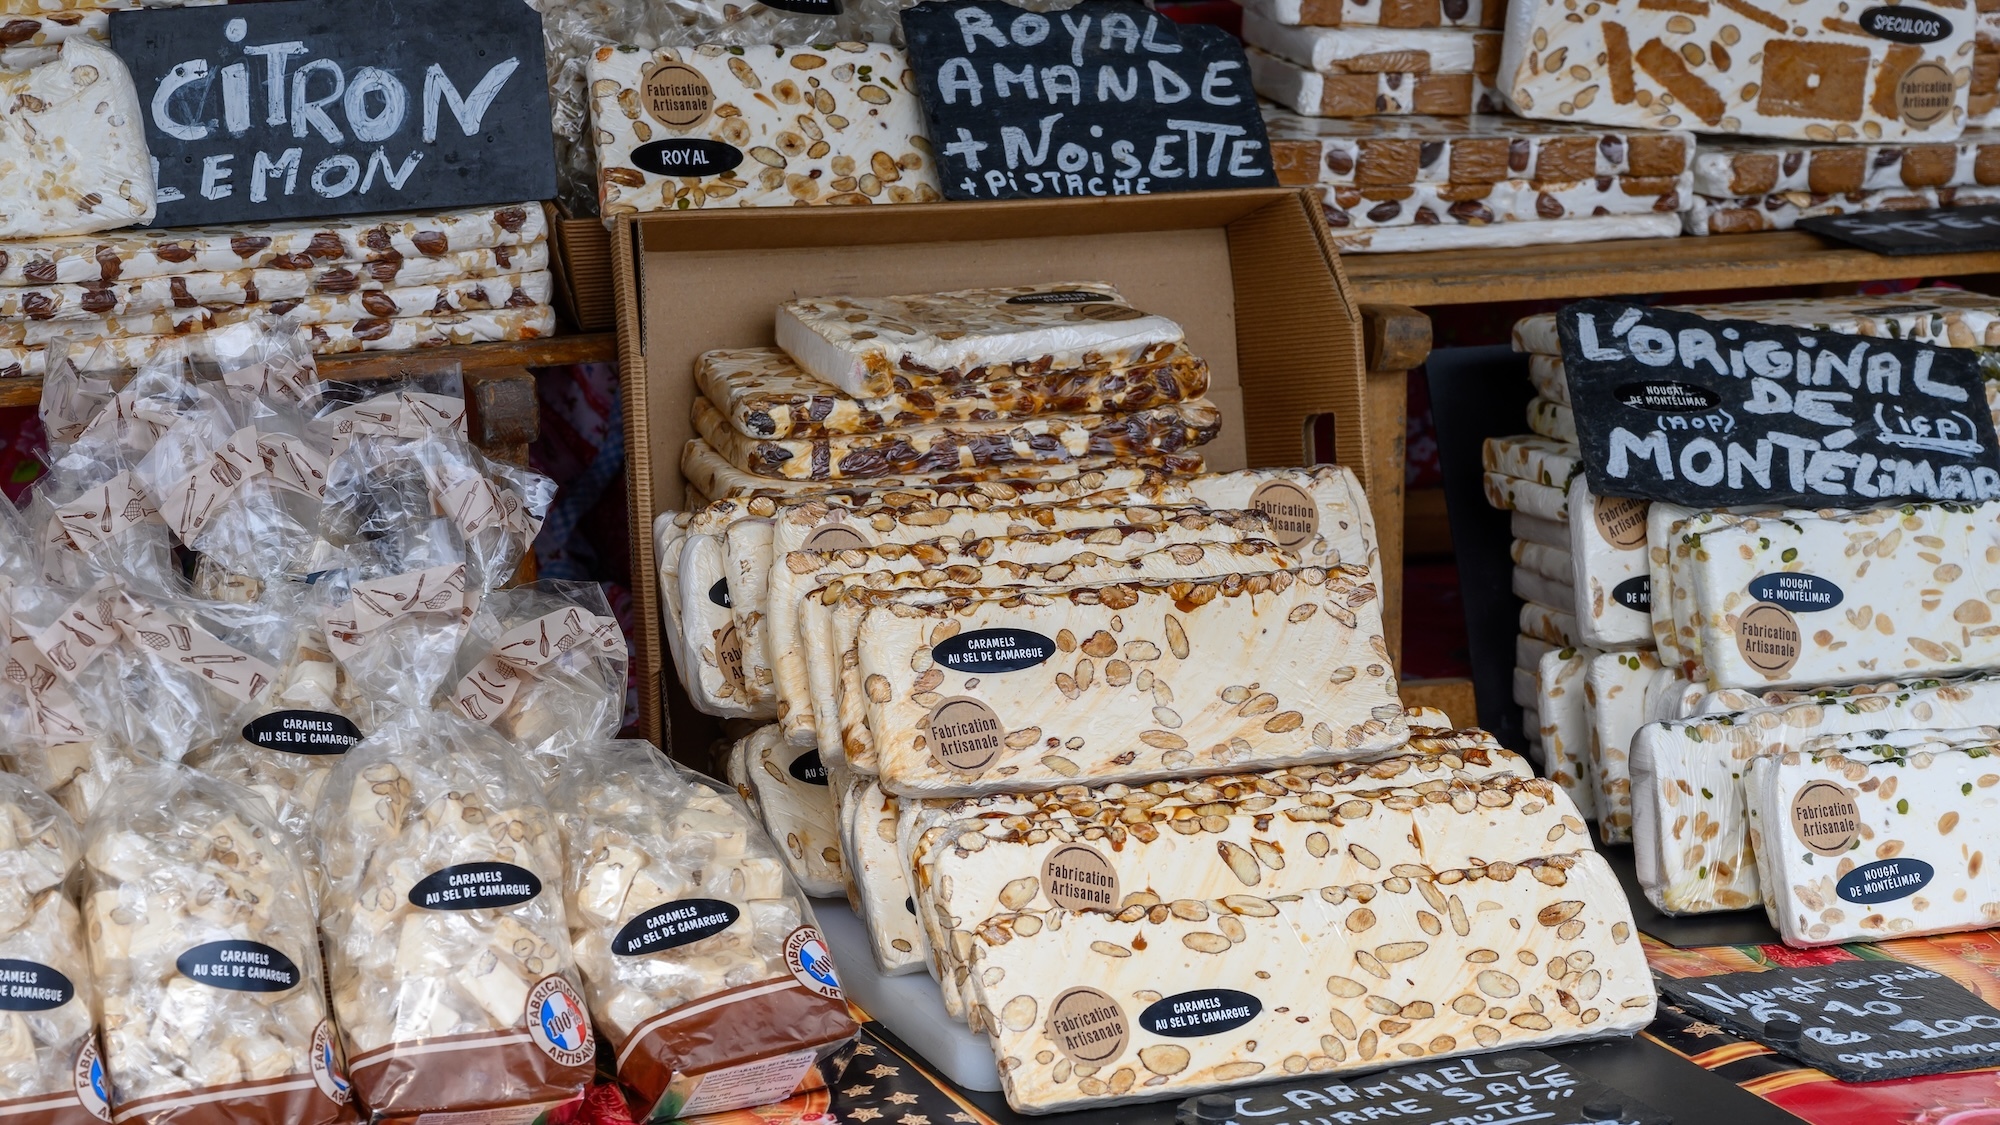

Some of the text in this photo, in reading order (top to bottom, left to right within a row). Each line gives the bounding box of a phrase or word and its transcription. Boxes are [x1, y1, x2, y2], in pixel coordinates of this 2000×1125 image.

[1873, 14, 1940, 37] SPECULOOS
[954, 6, 1183, 67] ROYAL
[647, 83, 708, 96] Fabrication
[937, 57, 1241, 106] AMANDE
[1901, 81, 1952, 95] Fabrication
[653, 98, 707, 111] Artisanale
[1903, 95, 1949, 109] Artisanale
[661, 148, 710, 166] ROYAL
[943, 127, 989, 171] +
[151, 145, 424, 204] LEMON
[960, 177, 979, 197] +
[1646, 385, 1684, 396] NOUGAT
[1629, 394, 1708, 407] DE MONTÉLIMAR
[1743, 376, 1855, 427] DE
[1780, 577, 1813, 590] NOUGAT
[1626, 592, 1637, 603] DE
[1762, 588, 1831, 604] DE MONTÉLIMAR
[1742, 622, 1797, 642] Fabrication
[968, 636, 1016, 650] CARAMELS
[1745, 638, 1795, 657] Artisanale
[948, 647, 1044, 665] AU SEL DE CAMARGUE
[283, 718, 333, 732] CARAMELS
[931, 717, 997, 740] Fabrication
[258, 731, 272, 742] AU
[275, 731, 292, 742] SEL
[295, 732, 307, 743] DE
[940, 734, 999, 756] Artisanale
[804, 768, 817, 779] AU
[1796, 802, 1854, 821] Fabrication
[1803, 818, 1855, 837] Artisanale
[449, 871, 502, 887] CARAMELS
[1048, 862, 1114, 888] Fabrication
[1864, 863, 1900, 881] NOUGAT
[426, 884, 531, 905] AU SEL DE CAMARGUE
[1051, 880, 1111, 904] Artisanale
[1849, 872, 1921, 898] DE MONTÉLIMAR
[646, 906, 697, 929] CARAMELS
[627, 912, 729, 952] AU SEL DE CAMARGUE
[220, 950, 269, 966] CARAMELS
[193, 964, 291, 984] AU SEL DE CAMARGUE
[10, 985, 63, 1002] CAMARGUE
[1687, 976, 1826, 1015] Nougat
[1173, 997, 1221, 1014] CARAMELS
[1053, 1005, 1119, 1035] Fabrication
[1155, 1006, 1250, 1031] AU SEL DE CAMARGUE
[1888, 1015, 2000, 1039] 100
[1065, 1021, 1123, 1051] Artisanale
[1442, 1063, 1579, 1104] SALÉ
